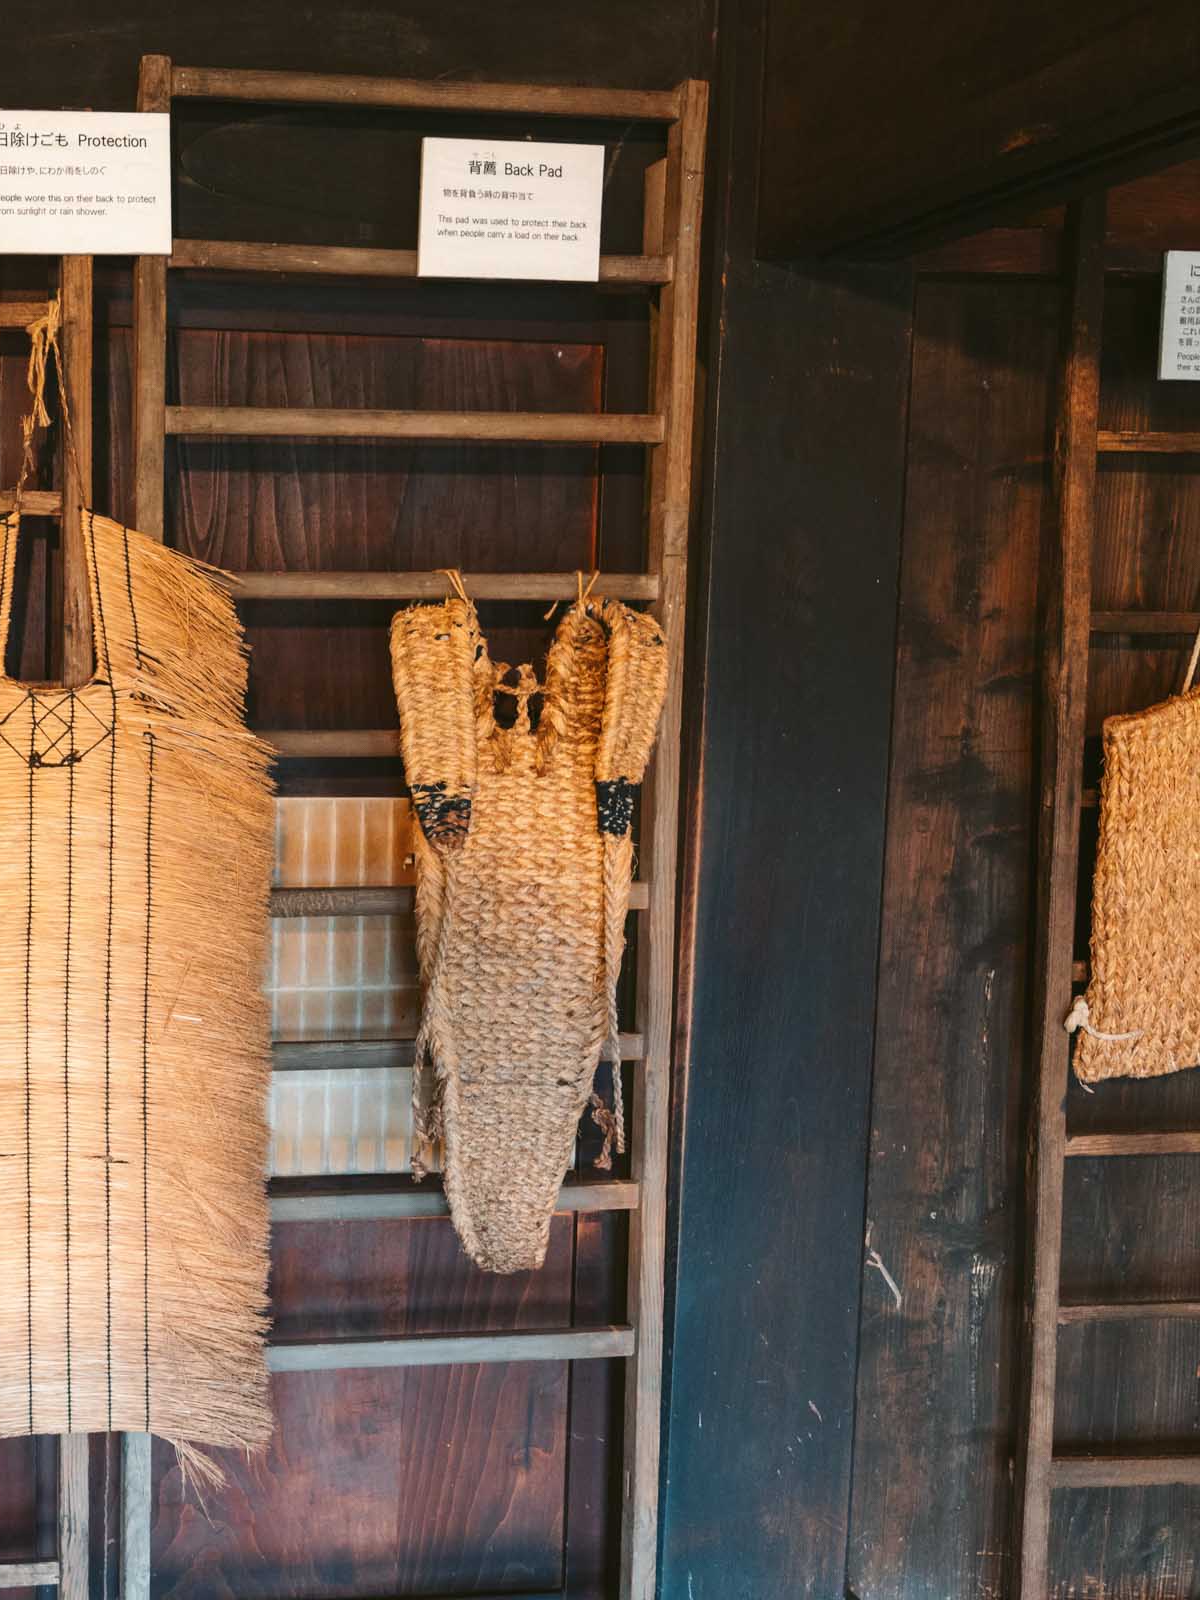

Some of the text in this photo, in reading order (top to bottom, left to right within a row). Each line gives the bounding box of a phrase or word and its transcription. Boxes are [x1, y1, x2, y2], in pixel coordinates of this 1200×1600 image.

[78, 133, 147, 148] Protection
[504, 162, 534, 177] Back
[539, 164, 563, 178] Pad
[25, 195, 46, 203] wore
[48, 193, 62, 203] this
[64, 195, 74, 203] on
[95, 194, 113, 203] back
[116, 195, 125, 204] to
[127, 195, 156, 205] protect
[17, 207, 46, 217] sunlight
[49, 209, 57, 217] or
[60, 207, 74, 216] rain
[438, 214, 452, 224] This
[455, 215, 469, 225] pad
[472, 217, 488, 225] was
[490, 216, 508, 226] used
[511, 217, 519, 226] to
[521, 218, 549, 228] protect
[570, 219, 587, 229] back
[437, 228, 458, 237] when
[460, 229, 485, 240] people
[487, 231, 505, 241] carry
[515, 230, 530, 240] load
[532, 232, 542, 240] on
